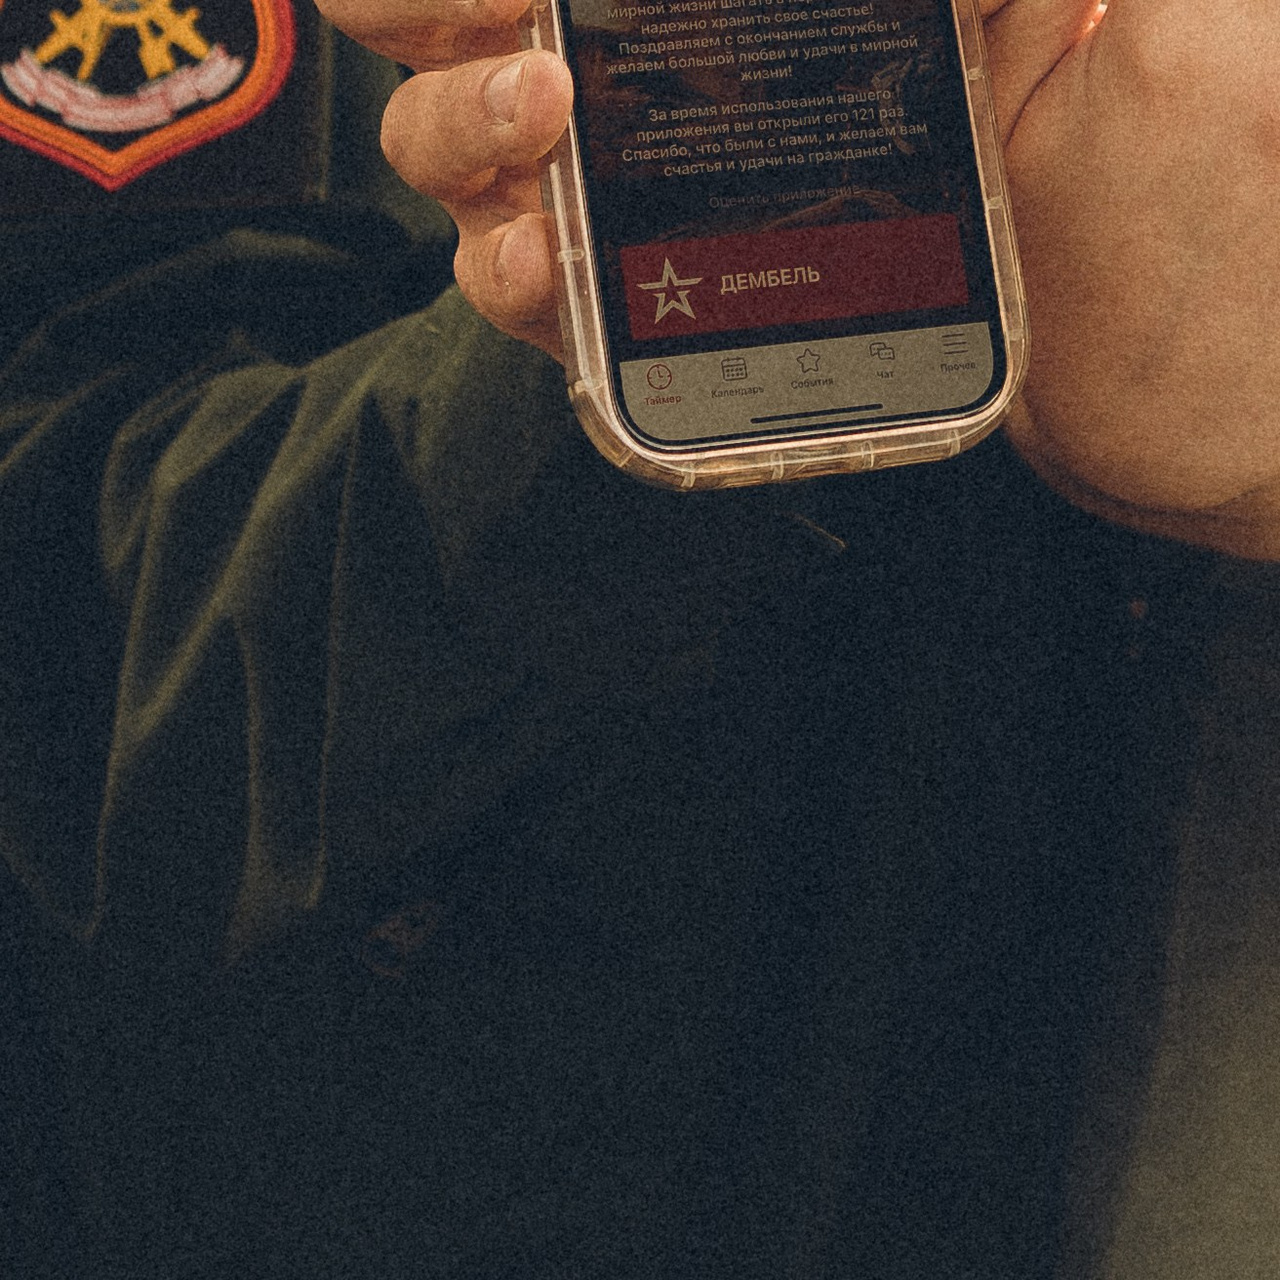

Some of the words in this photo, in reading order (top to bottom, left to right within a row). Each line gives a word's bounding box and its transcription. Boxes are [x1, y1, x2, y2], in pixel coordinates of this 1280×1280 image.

[607, 2, 665, 19] мирной
[669, 0, 716, 13] жизни
[641, 19, 707, 35] надежно
[711, 14, 771, 30] хранить
[774, 10, 808, 23] свое
[812, 4, 874, 20] счастье!
[619, 37, 720, 55] Поздравляем
[725, 34, 733, 45] с
[737, 26, 827, 44] окончанием
[830, 20, 888, 38] службы
[891, 20, 900, 31] и
[606, 59, 665, 75] желаем
[668, 51, 735, 69] большой
[738, 48, 786, 62] любви
[790, 47, 799, 58] и
[803, 42, 846, 60] удачи
[850, 42, 858, 53] в
[862, 36, 918, 53] мирной
[741, 66, 792, 81] жизни!
[649, 109, 667, 122] За
[671, 105, 718, 122] время
[722, 95, 834, 115] использования
[838, 89, 891, 104] нашего
[636, 124, 730, 142] приложения
[734, 120, 754, 132] вы
[757, 115, 820, 131] открыли
[824, 111, 848, 123] его
[852, 108, 875, 121] 121
[879, 107, 908, 121] раз.
[622, 144, 691, 162] Спасибо,
[695, 142, 721, 155] что
[724, 136, 763, 152] были
[768, 136, 776, 147] с
[780, 133, 822, 147] нами,
[826, 132, 835, 142] и
[839, 126, 897, 141] желаем
[900, 123, 927, 135] вам
[664, 161, 722, 176] счастья
[726, 160, 735, 171] и
[740, 155, 783, 172] удачи
[787, 152, 804, 165] на
[808, 144, 893, 163] гражданке!
[709, 194, 769, 209] Оценить
[721, 266, 819, 295] ДЕМБЕЛЬ
[877, 370, 894, 379] Чат
[941, 361, 976, 372] Прочее
[711, 385, 764, 398] Календарь
[791, 377, 834, 389] События
[644, 395, 682, 406] Таймер
